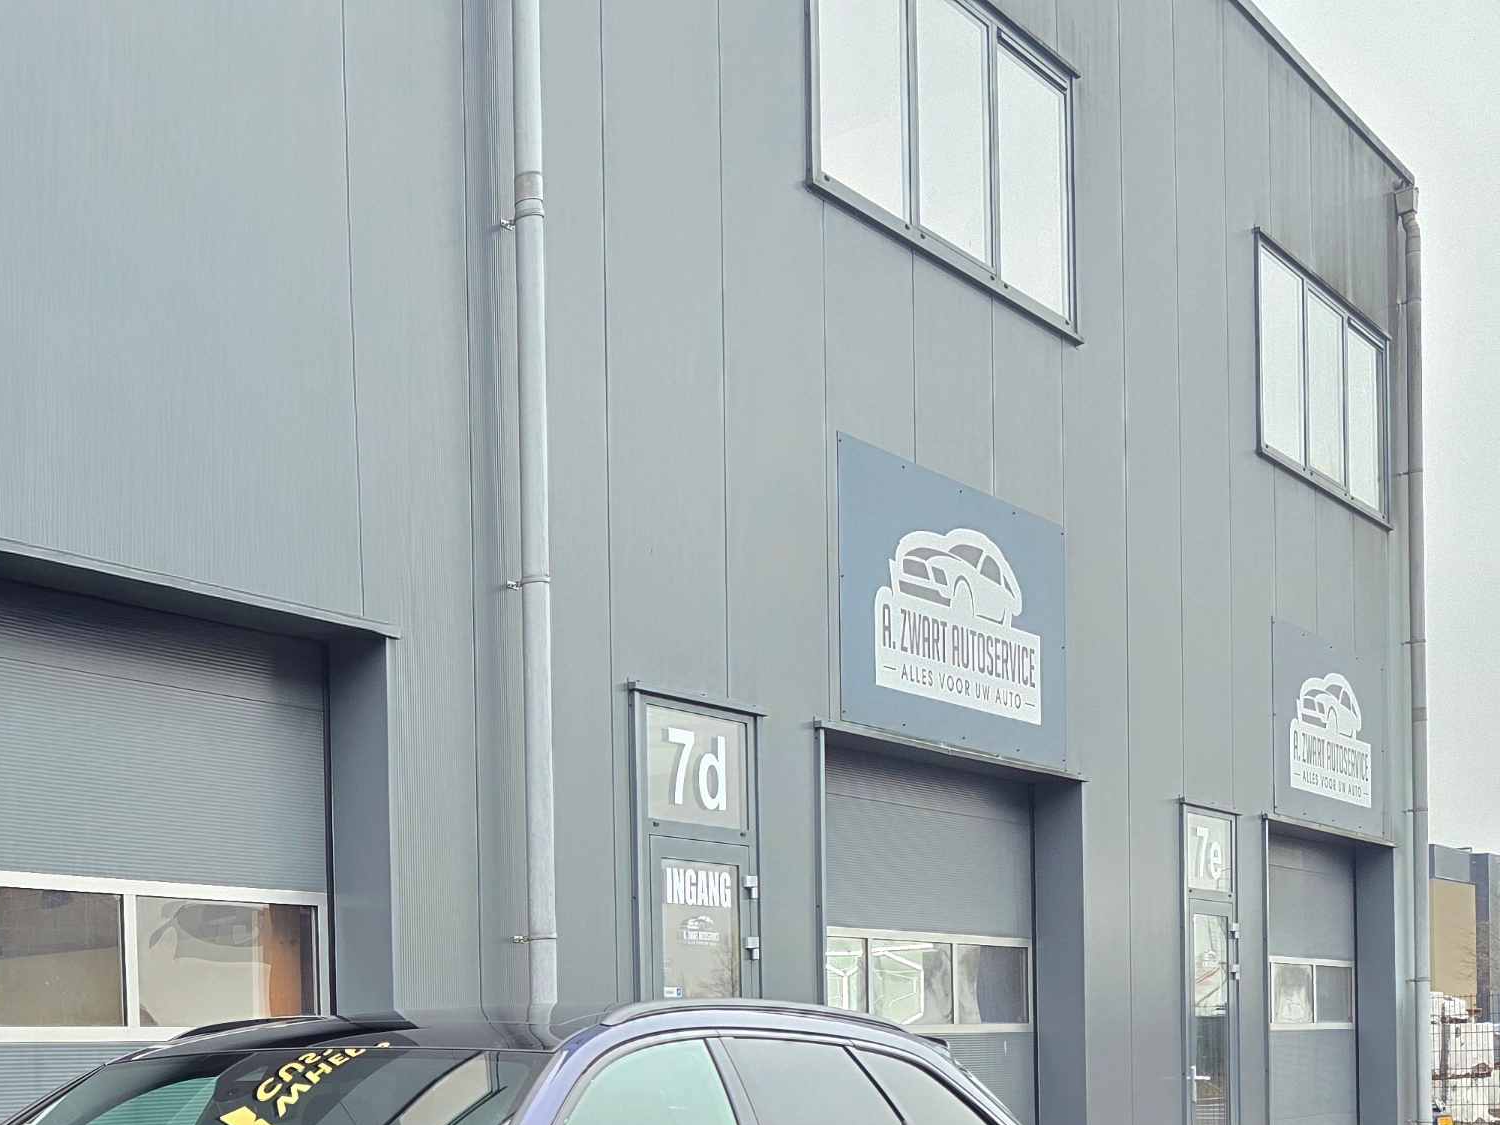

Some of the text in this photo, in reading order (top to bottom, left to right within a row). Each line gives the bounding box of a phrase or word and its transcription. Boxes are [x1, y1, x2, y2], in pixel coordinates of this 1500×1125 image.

[882, 603, 1036, 689] A. ZWART AUTOSERVICE
[901, 663, 1022, 709] ALLES VOOR UW AUTO
[668, 726, 727, 811] 7d
[1302, 732, 1325, 768] ZWART
[1326, 741, 1368, 782] AUTOSERVICE
[1303, 770, 1319, 785] ALLES
[1321, 775, 1336, 790] VOOR
[1348, 784, 1362, 797] AUTO
[1196, 826, 1222, 880] 7e
[666, 867, 732, 908] INGANG
